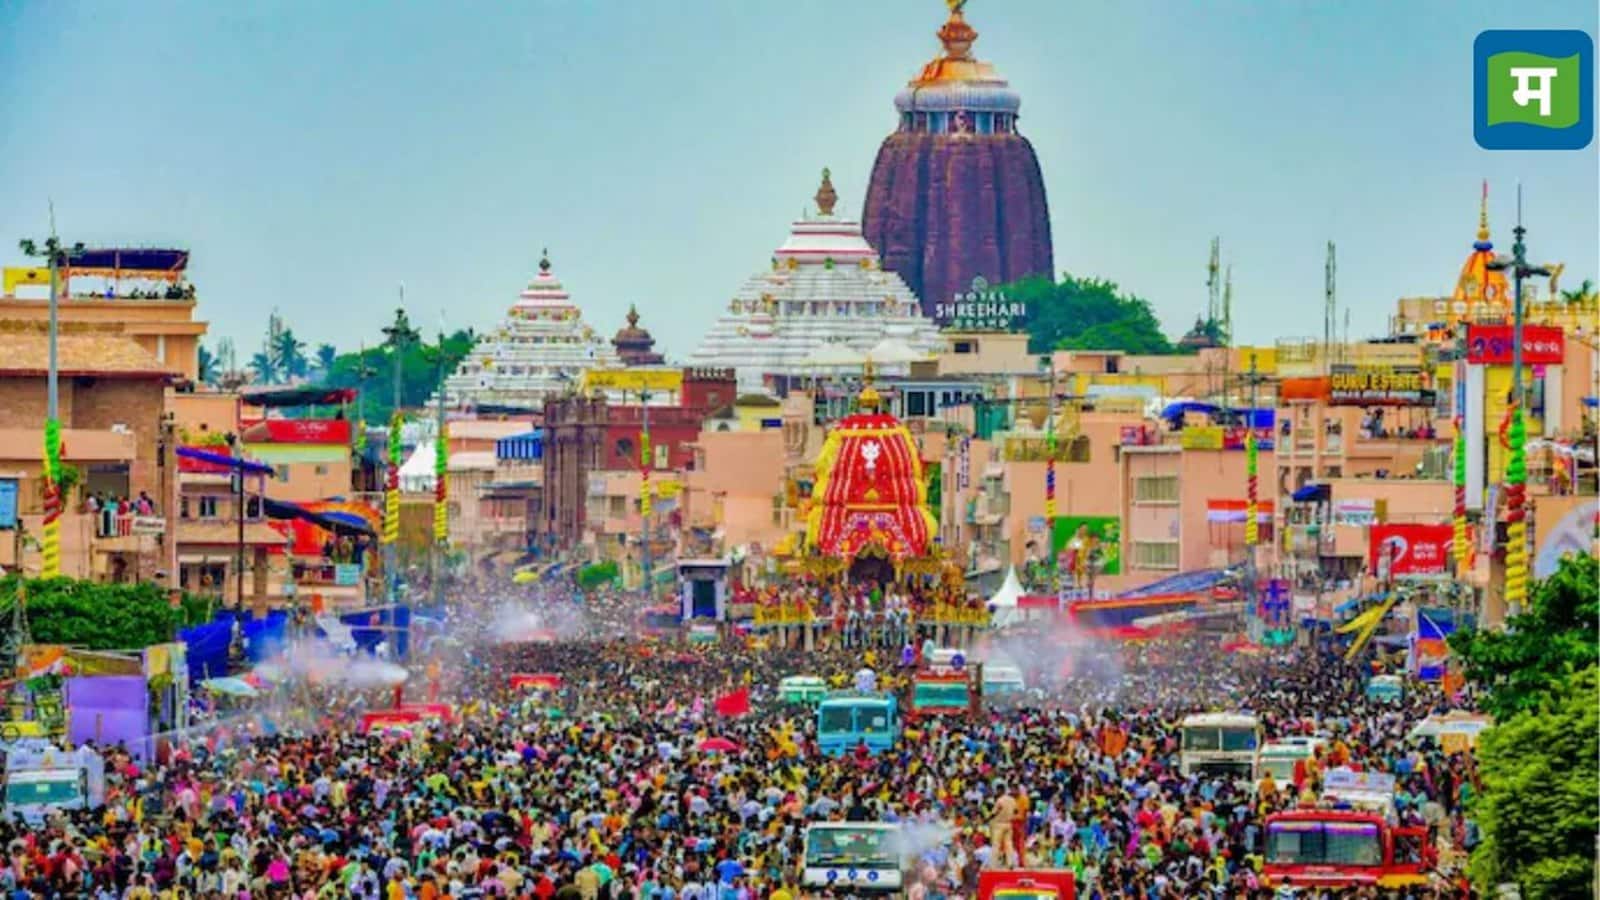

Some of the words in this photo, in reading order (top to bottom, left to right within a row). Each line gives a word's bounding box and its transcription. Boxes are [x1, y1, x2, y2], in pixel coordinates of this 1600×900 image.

[953, 292, 1006, 302] HOTEL
[935, 303, 1026, 318] SHREEHARI
[1332, 373, 1368, 390] GURU
[1371, 373, 1422, 391] ESTATE
